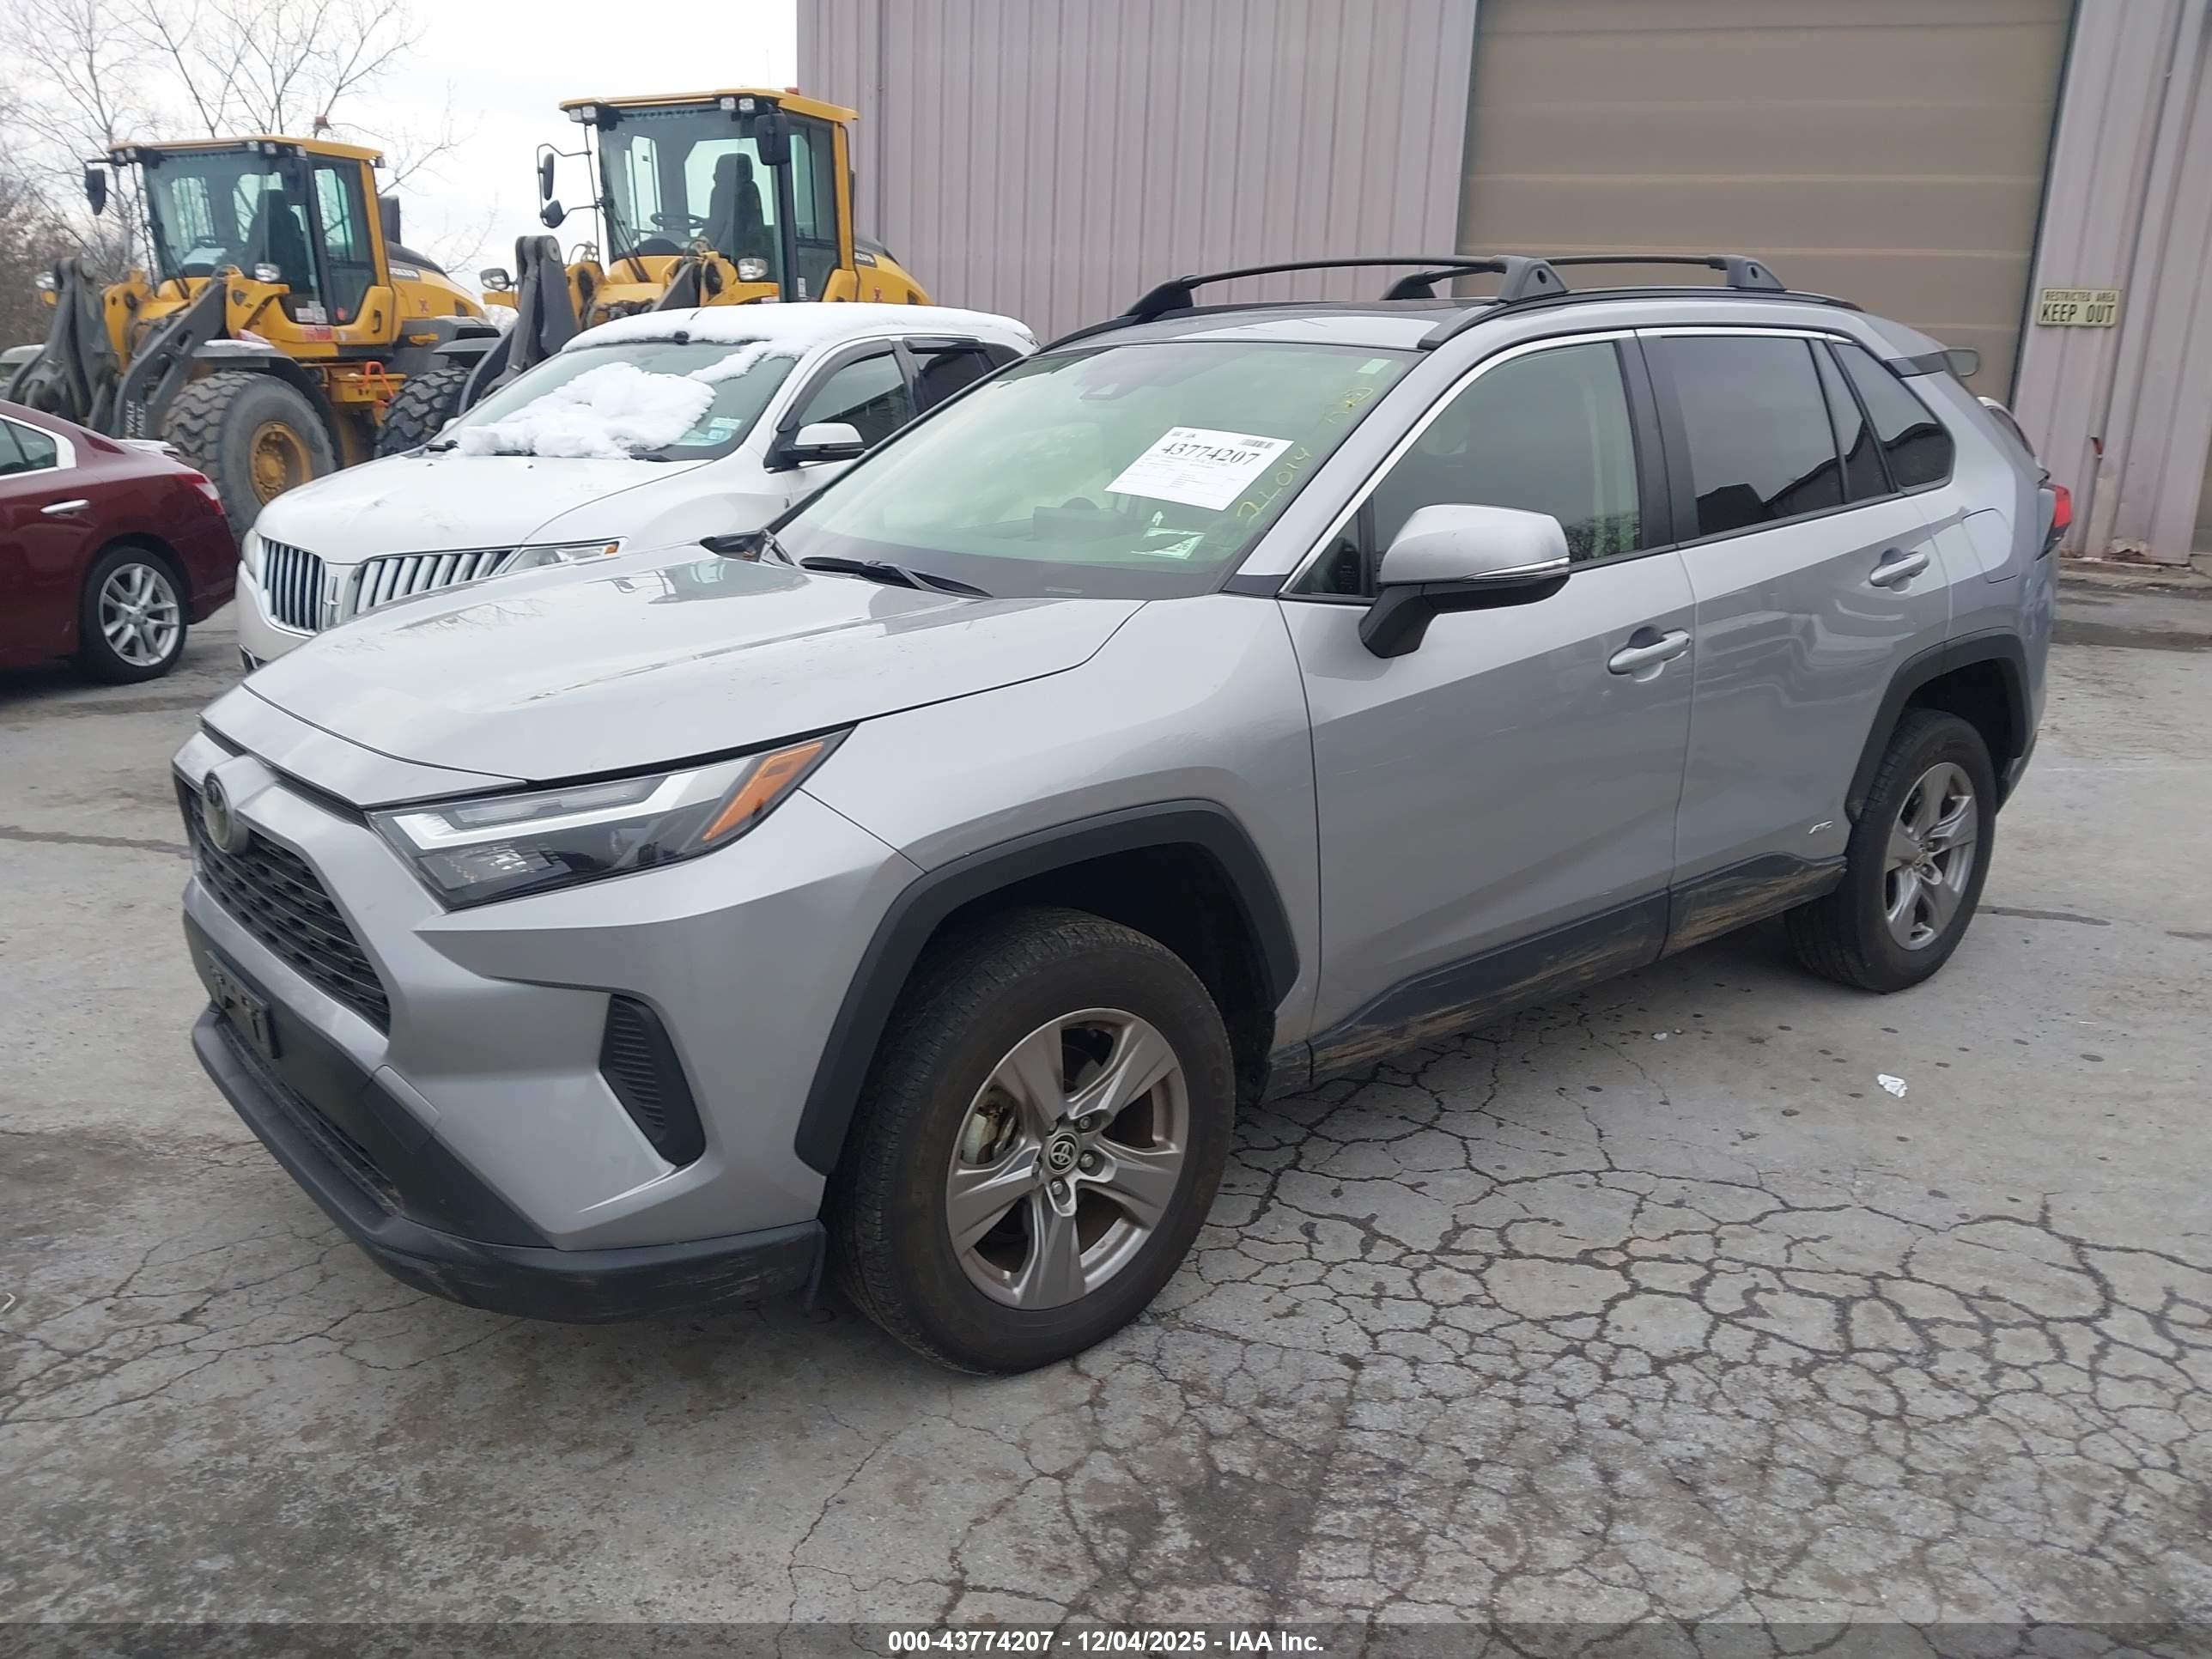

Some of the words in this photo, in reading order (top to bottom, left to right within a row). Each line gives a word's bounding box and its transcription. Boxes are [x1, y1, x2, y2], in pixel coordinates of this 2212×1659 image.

[2041, 303, 2077, 322] KEEP
[2086, 304, 2114, 323] OUT
[1161, 441, 1261, 465] 43774207
